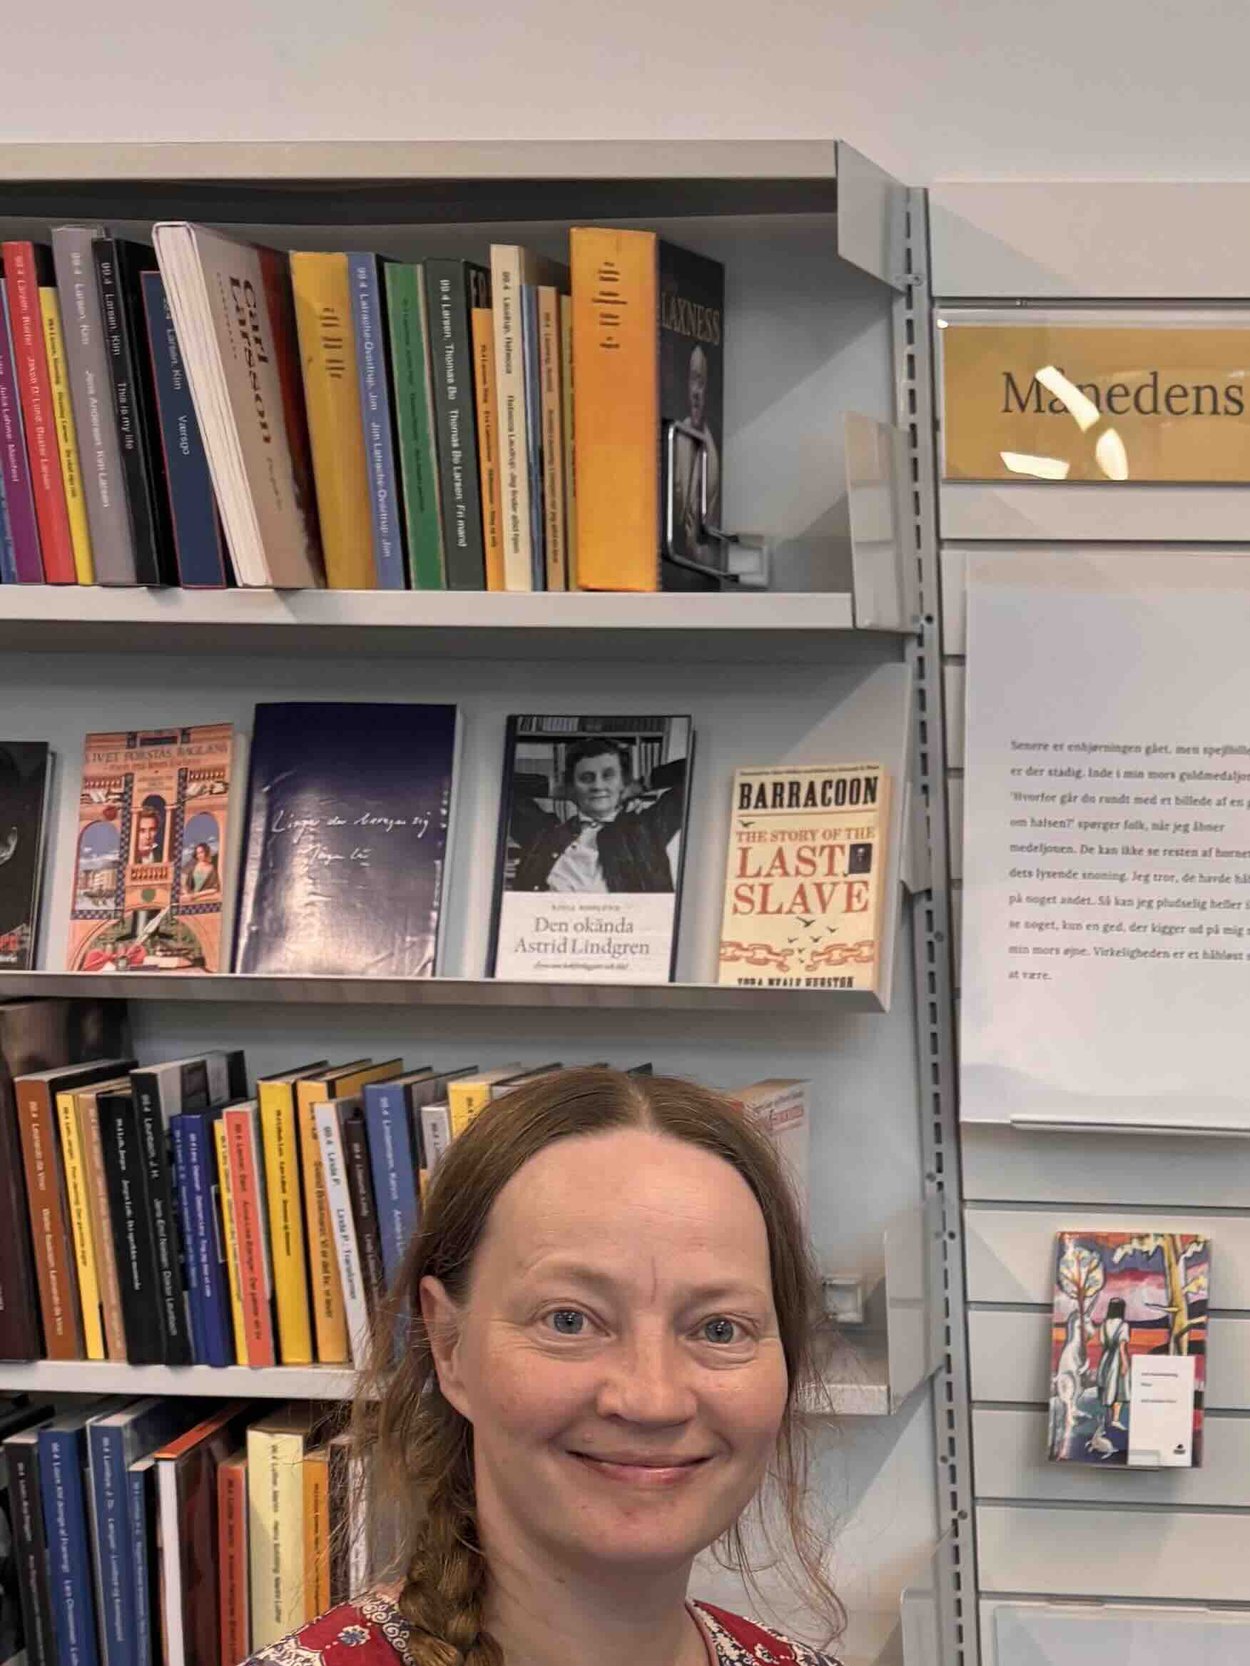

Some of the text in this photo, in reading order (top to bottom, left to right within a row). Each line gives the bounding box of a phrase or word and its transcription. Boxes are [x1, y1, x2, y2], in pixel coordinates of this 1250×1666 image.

[104, 293, 117, 329] Larsen,
[244, 279, 269, 363] Carl
[441, 303, 451, 337] Larsen,
[661, 292, 720, 346] LAXNESS
[110, 334, 120, 355] Kim
[229, 276, 272, 443] Larsson
[444, 343, 454, 383] Thomas
[117, 382, 126, 403] This
[447, 385, 457, 399] Bo
[1001, 367, 1245, 416] Månedens
[119, 405, 128, 414] is
[120, 416, 130, 432] my
[171, 369, 182, 391] Kim
[178, 414, 191, 455] Værsgo
[124, 434, 134, 449] life
[449, 409, 459, 447] Thomas
[451, 450, 461, 464] Bo
[456, 504, 465, 517] Fri
[456, 519, 467, 547] mand
[738, 776, 879, 811] BARRACOON
[736, 826, 876, 844] THE STORY OF THE
[735, 843, 846, 879] LAST
[731, 879, 871, 916] SLAVE
[534, 916, 634, 934] Den okända
[514, 936, 650, 958] Astrid Lindgren
